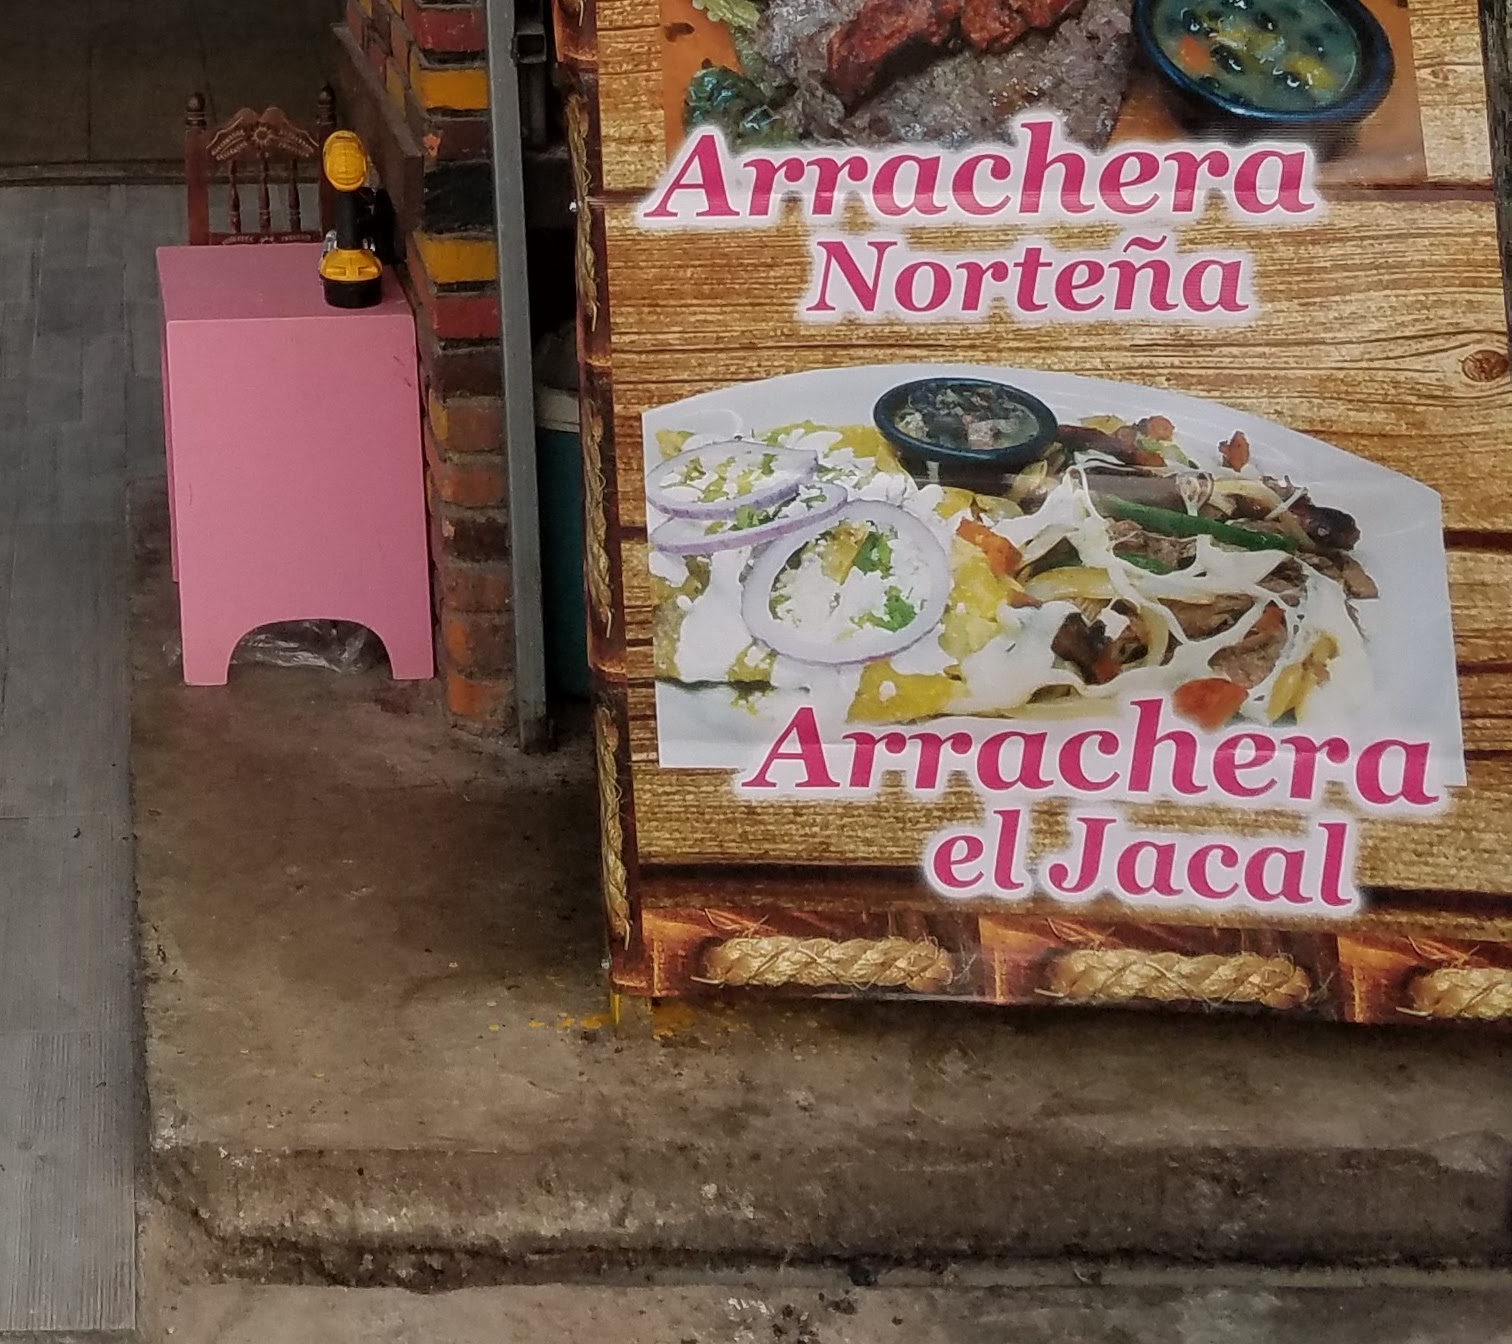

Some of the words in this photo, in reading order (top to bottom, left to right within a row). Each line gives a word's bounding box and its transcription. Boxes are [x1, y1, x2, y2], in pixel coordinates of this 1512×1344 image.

[643, 120, 1317, 219] Arrachera
[807, 235, 1250, 313] Norteña
[741, 699, 1440, 806] Arrachera
[933, 808, 1025, 890] el
[1049, 817, 1353, 907] Jacal
